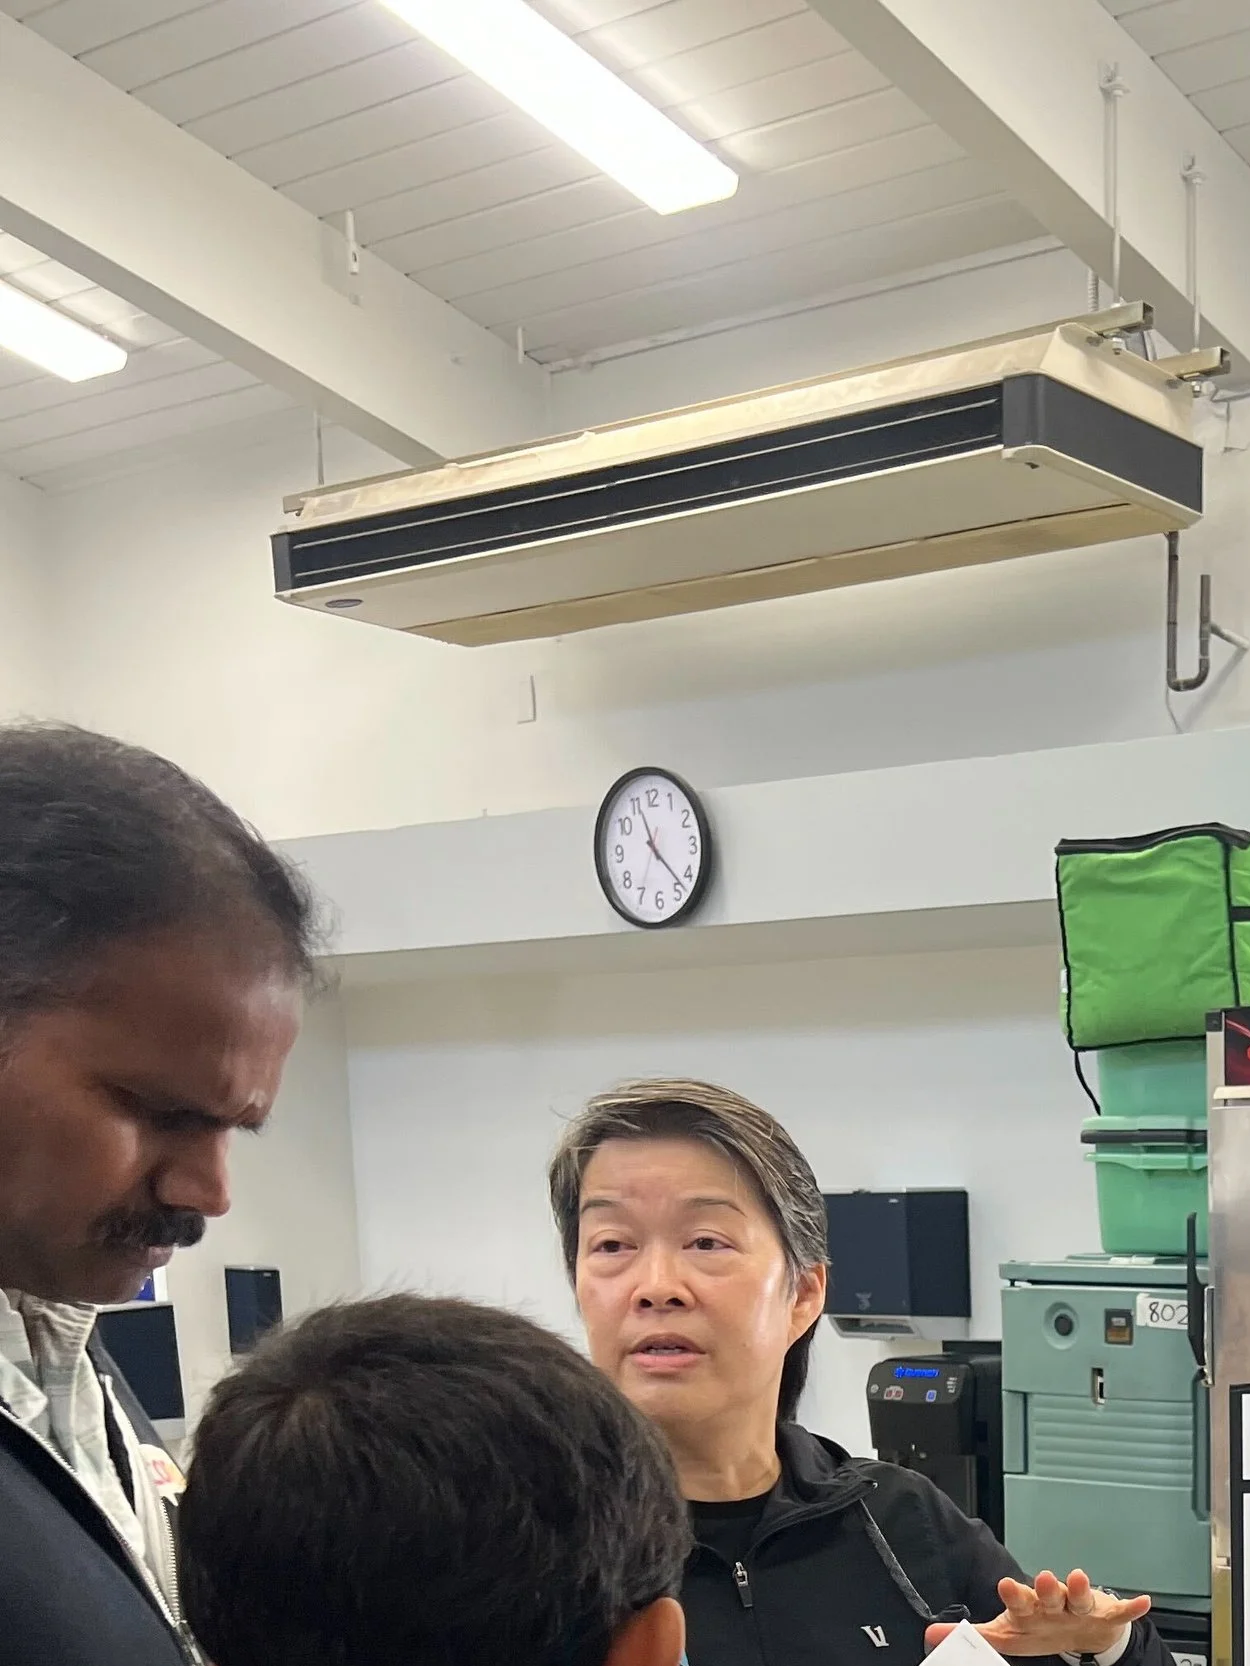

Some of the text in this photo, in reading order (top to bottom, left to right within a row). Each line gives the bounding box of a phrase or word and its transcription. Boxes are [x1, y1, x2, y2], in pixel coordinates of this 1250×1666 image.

[630, 797, 641, 815] 11
[645, 788, 659, 808] 12
[667, 793, 673, 811] 1
[618, 817, 632, 835] 10
[682, 809, 691, 828] 2
[615, 844, 624, 863] 9
[688, 835, 698, 854] 3
[623, 871, 632, 888] 8
[684, 865, 692, 882] 4
[637, 887, 646, 905] 7
[655, 891, 664, 910] 6
[673, 882, 682, 901] 5
